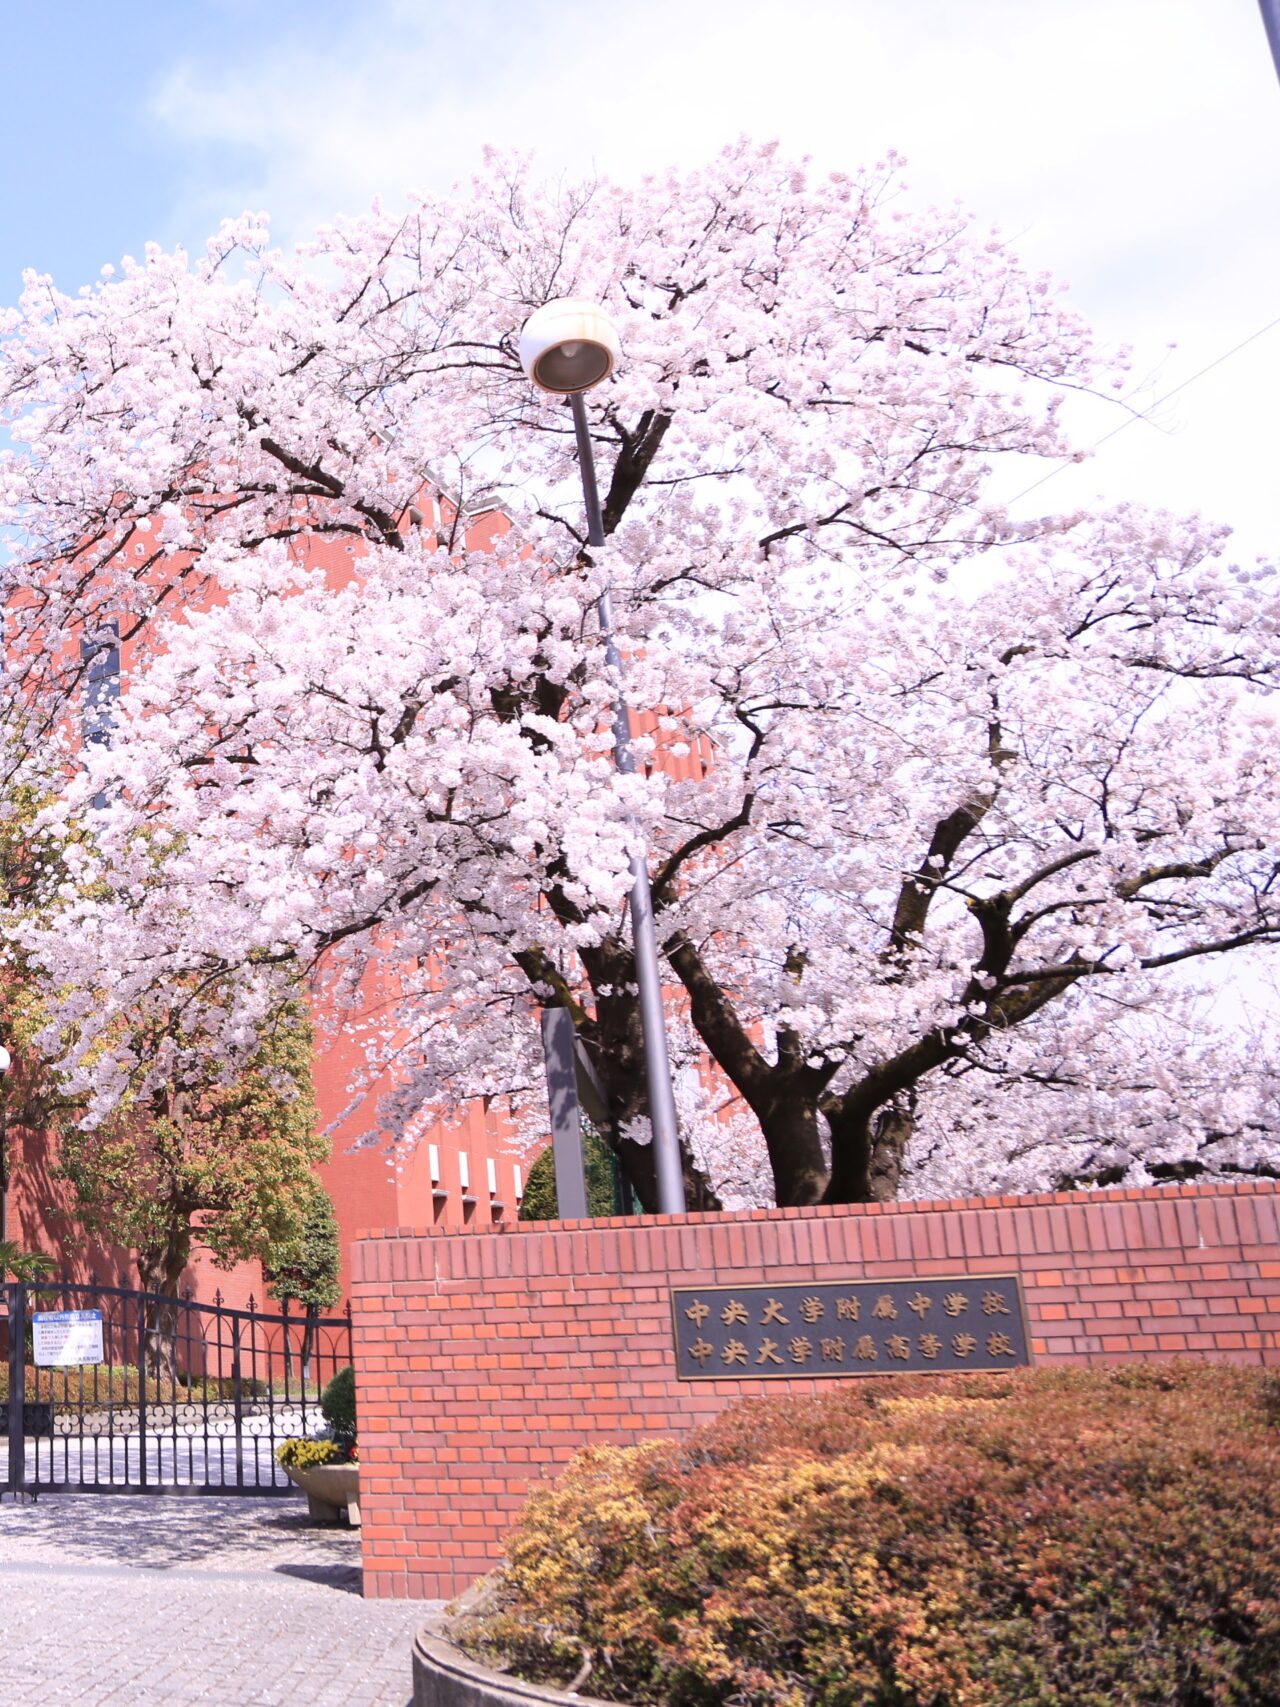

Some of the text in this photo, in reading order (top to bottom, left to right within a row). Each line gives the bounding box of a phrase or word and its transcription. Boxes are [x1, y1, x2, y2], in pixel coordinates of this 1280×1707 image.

[684, 1290, 1012, 1328] 中央大学附属中学校
[688, 1331, 1017, 1368] 中央大学附属高等学校
